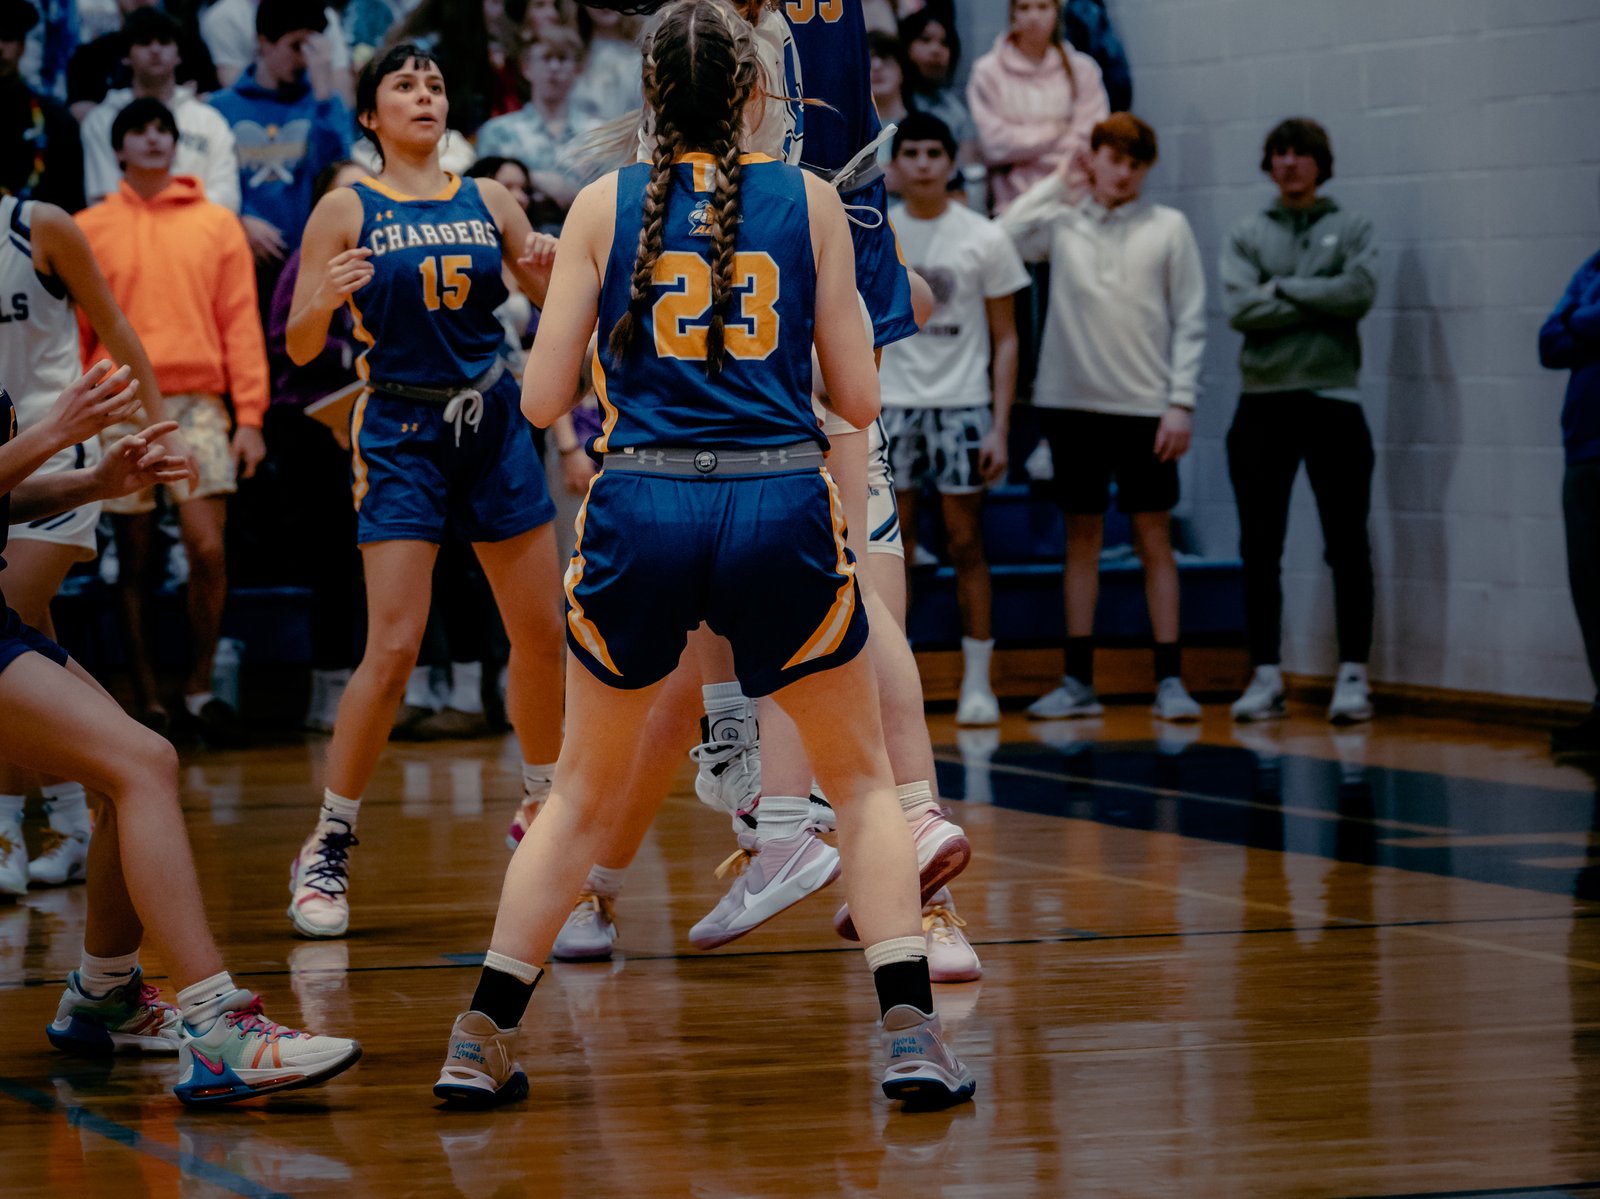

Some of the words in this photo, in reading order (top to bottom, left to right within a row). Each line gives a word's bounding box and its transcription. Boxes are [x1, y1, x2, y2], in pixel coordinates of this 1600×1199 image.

[370, 219, 498, 256] CHARGERS
[418, 254, 473, 312] 15
[651, 251, 780, 361] 23
